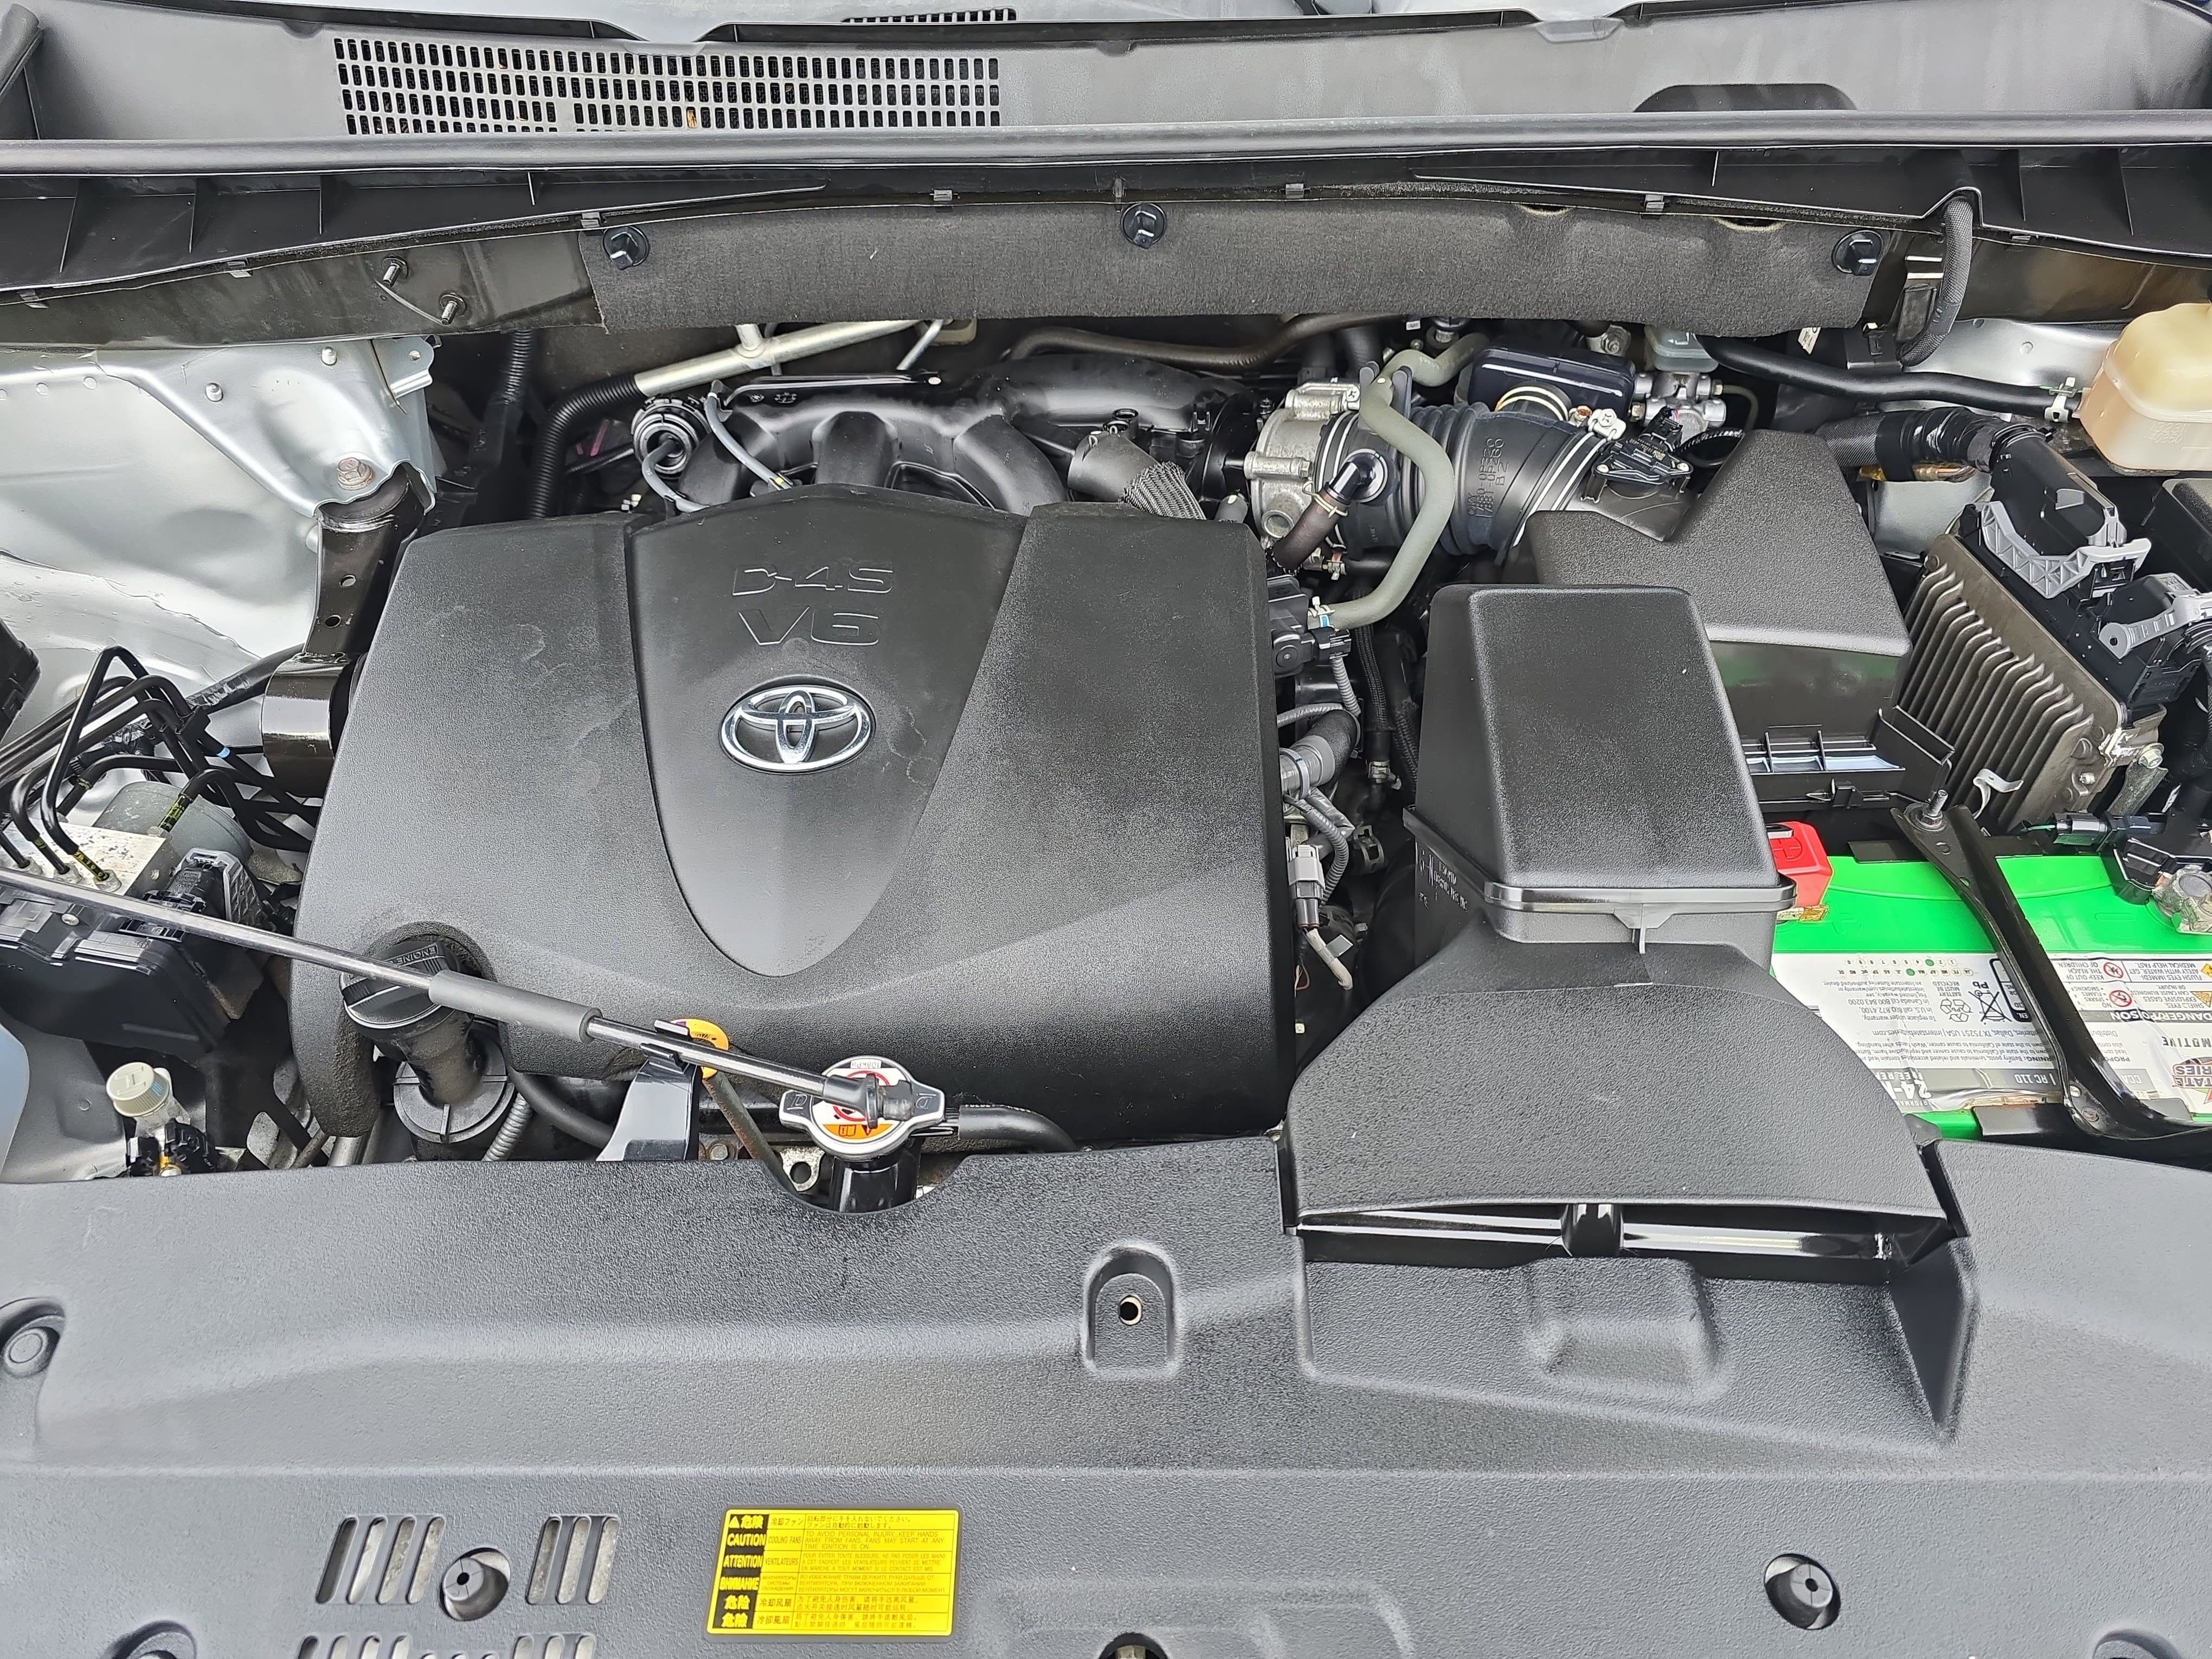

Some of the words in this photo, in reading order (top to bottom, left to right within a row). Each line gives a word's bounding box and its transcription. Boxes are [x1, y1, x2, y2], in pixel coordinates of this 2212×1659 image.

[732, 565, 893, 596] D-4S
[735, 607, 880, 645] V6
[396, 947, 436, 965] ENGINE
[2014, 1074, 2034, 1084] 110
[2034, 1074, 2048, 1084] RC
[2120, 1075, 2143, 1084] CCA
[727, 1533, 766, 1546] CAUTION
[768, 1536, 788, 1544] COOLING
[790, 1536, 801, 1544] FANS
[723, 1554, 763, 1568] ATTENTION
[719, 1577, 760, 1590] ВНИМАНИЕ
